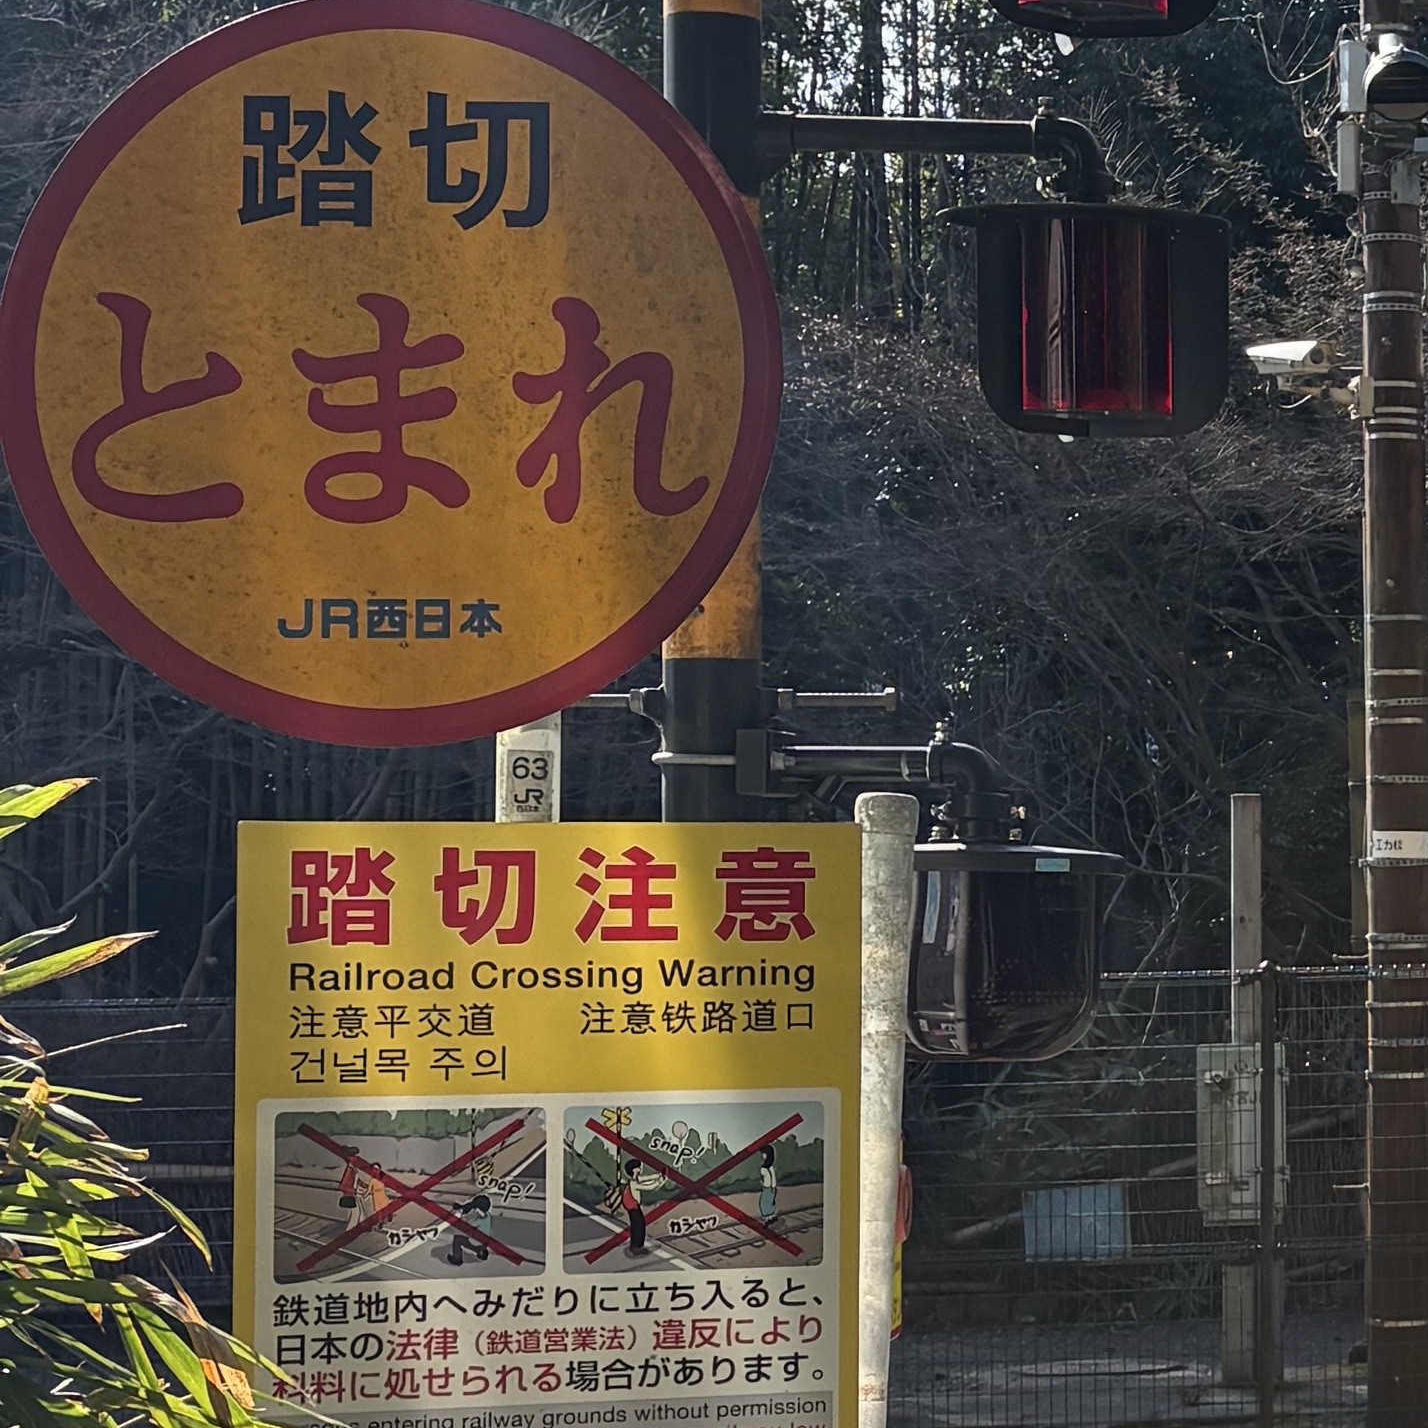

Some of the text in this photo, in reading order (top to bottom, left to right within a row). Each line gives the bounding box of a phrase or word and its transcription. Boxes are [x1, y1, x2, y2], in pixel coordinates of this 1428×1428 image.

[237, 89, 551, 229] 踏切
[71, 292, 710, 524] とまれ
[277, 598, 502, 639] JR西日本
[512, 756, 549, 781] 63
[513, 788, 544, 805] JR
[286, 845, 817, 947] 踏切注意
[290, 958, 816, 995] Railroad Crossing Warning
[289, 1002, 495, 1039] 注意平交道
[580, 998, 814, 1037] 注意铁路道口
[290, 1044, 508, 1085] 건널목 주의
[648, 1137, 706, 1166] snap!
[477, 1174, 535, 1203] snap!
[273, 1277, 823, 1327] 鉄道地内へみだりに立ち入ると、
[635, 1402, 709, 1422] without
[717, 1398, 826, 1425] permission
